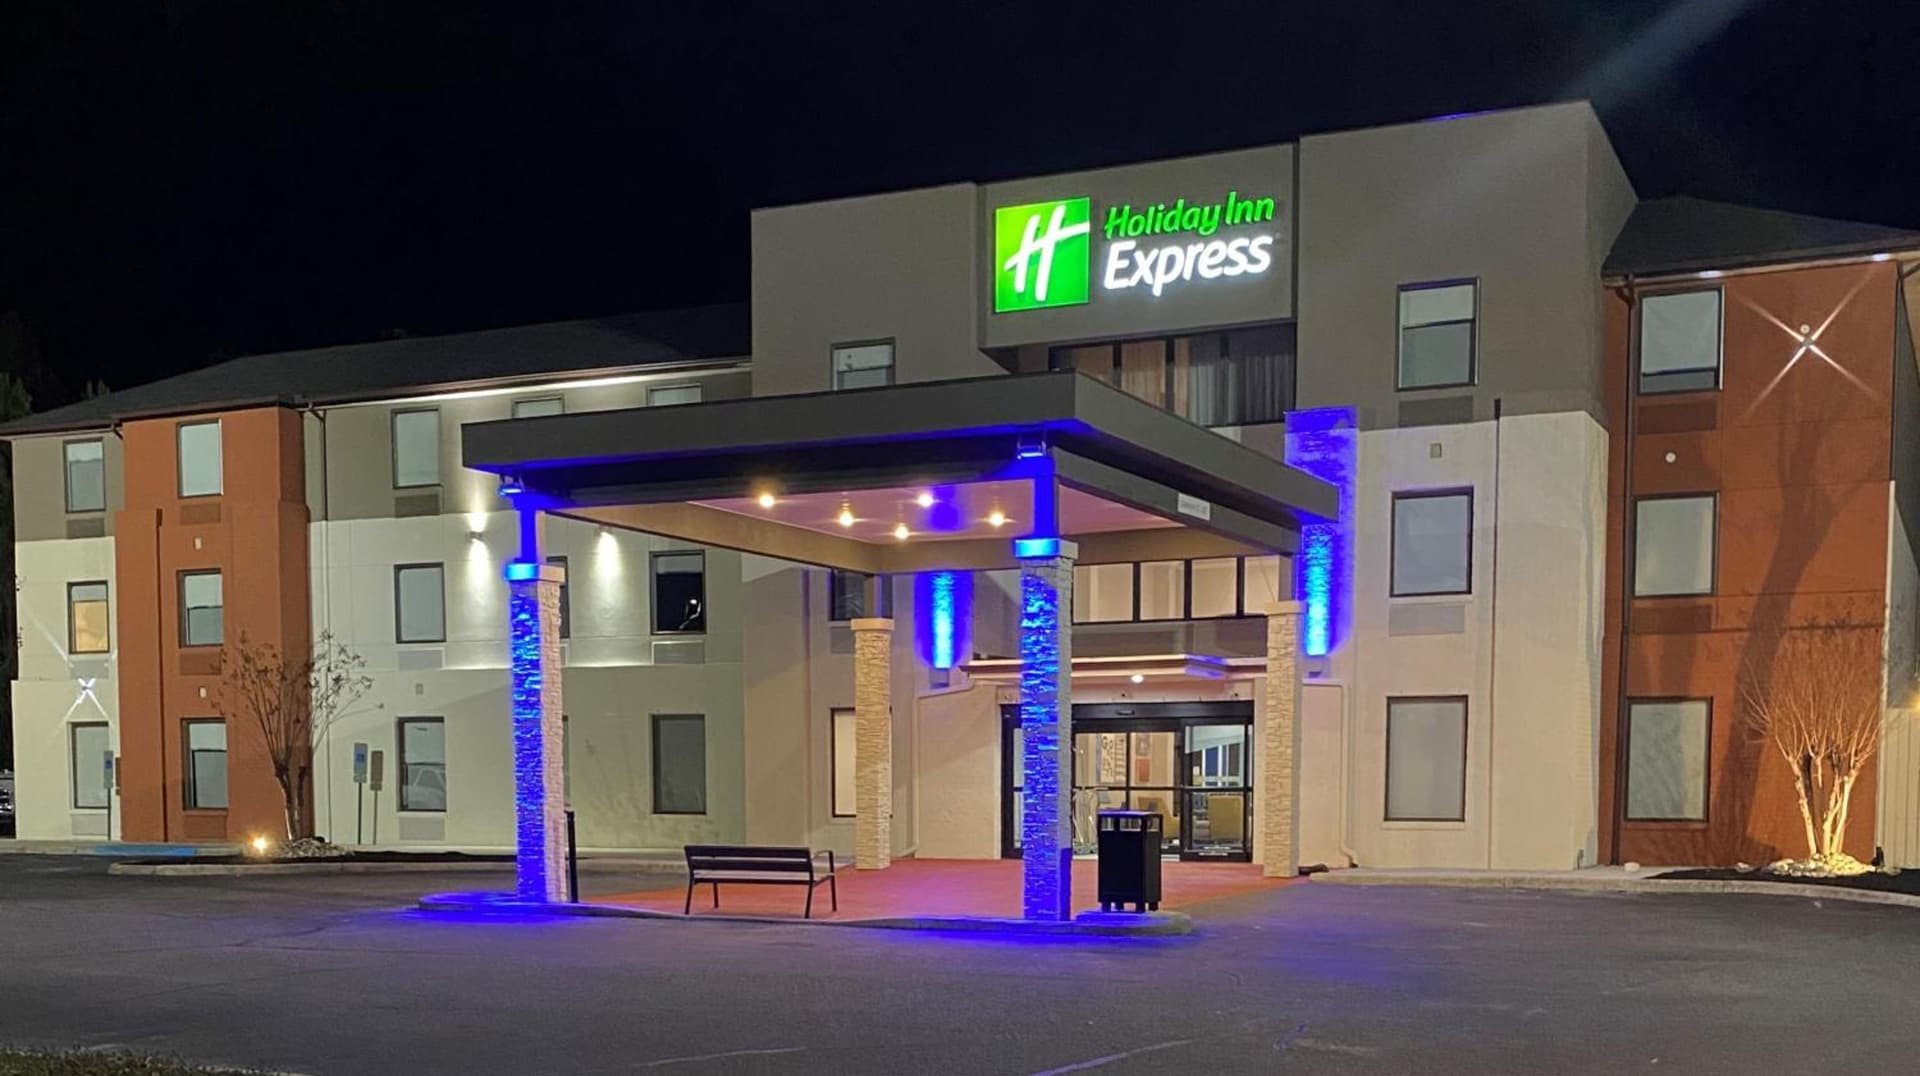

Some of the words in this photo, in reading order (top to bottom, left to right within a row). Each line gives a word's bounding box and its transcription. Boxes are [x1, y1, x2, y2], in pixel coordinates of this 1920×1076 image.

[1104, 198, 1221, 240] Holiday
[1225, 191, 1275, 225] Inn
[1004, 204, 1090, 302] H
[1103, 234, 1274, 297] Express
